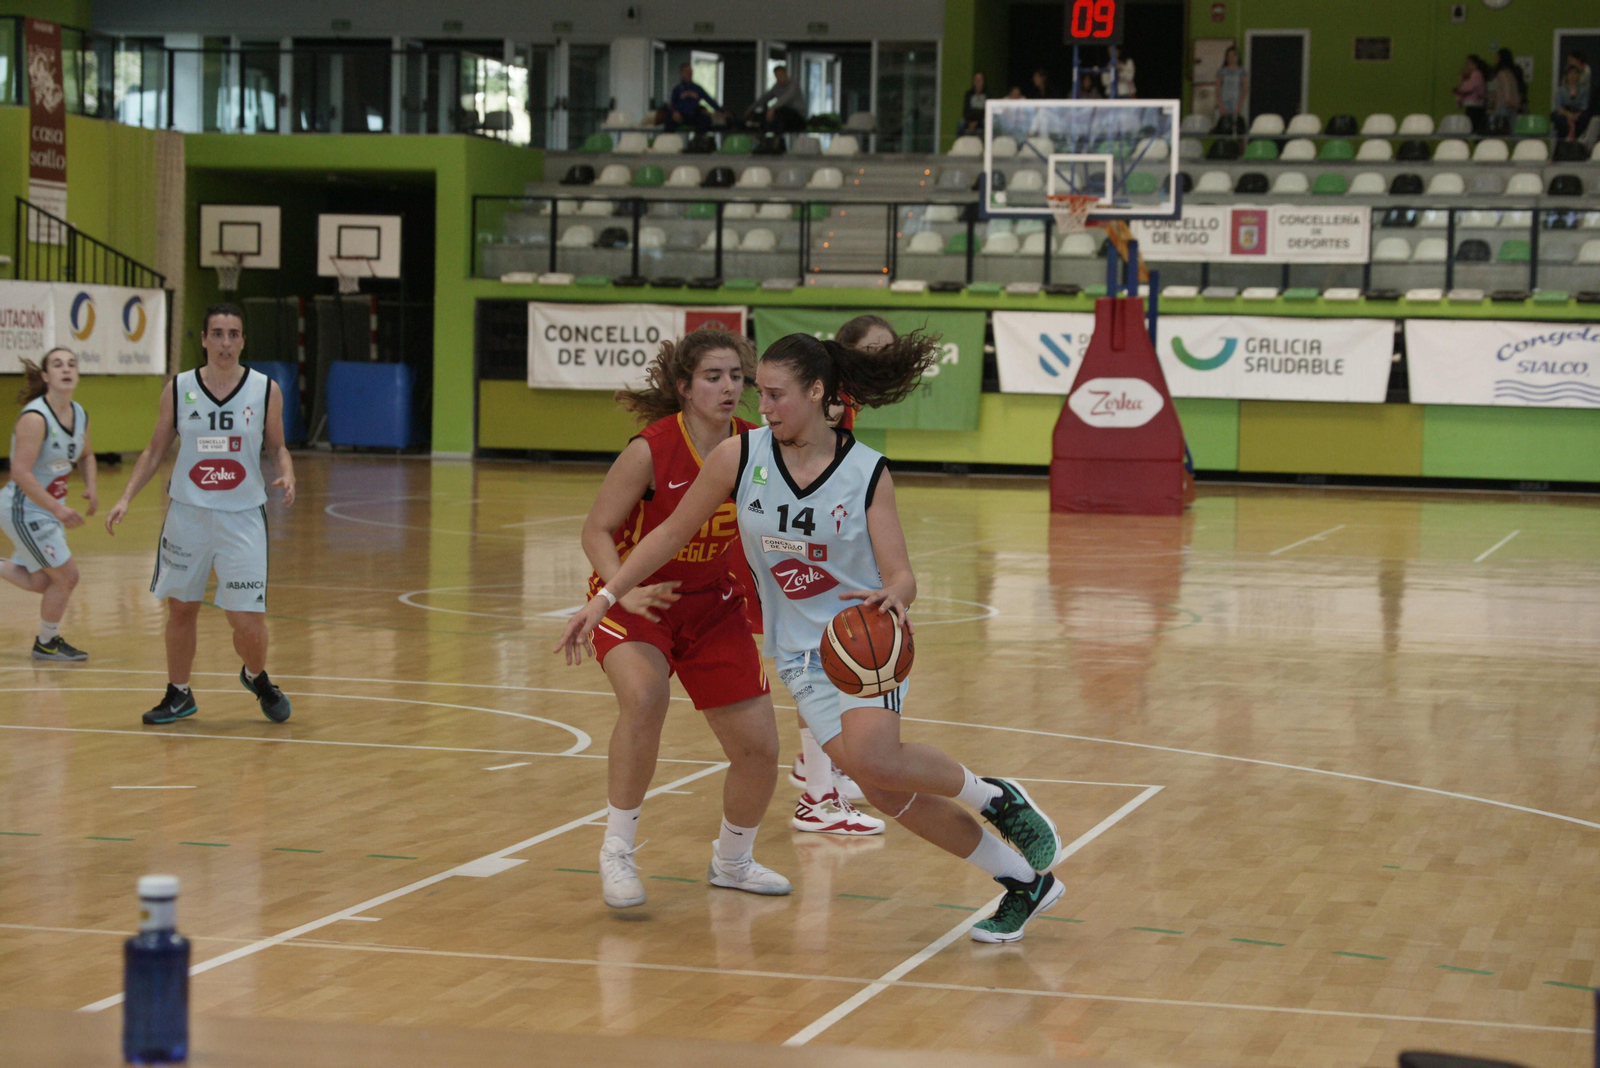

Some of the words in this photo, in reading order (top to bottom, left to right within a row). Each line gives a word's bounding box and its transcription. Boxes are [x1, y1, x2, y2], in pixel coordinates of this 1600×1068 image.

[1071, 0, 1115, 38] 09
[1142, 217, 1219, 231] CONCELLO
[1152, 232, 1171, 244] DE
[1174, 231, 1210, 245] VIGO
[1287, 238, 1351, 249] DEPORTES
[544, 324, 660, 344] CONCELLO
[1244, 337, 1322, 355] GALICIA
[558, 348, 586, 366] DE
[595, 349, 646, 366] VIGO
[1244, 356, 1345, 376] SAUDABLE
[1088, 389, 1144, 416] Zorka
[208, 411, 234, 430] 16
[199, 466, 236, 485] Zorka
[777, 504, 816, 536] 14
[672, 542, 719, 562] EGLE
[229, 581, 265, 590] ABANCA
[775, 567, 825, 593] Zork
